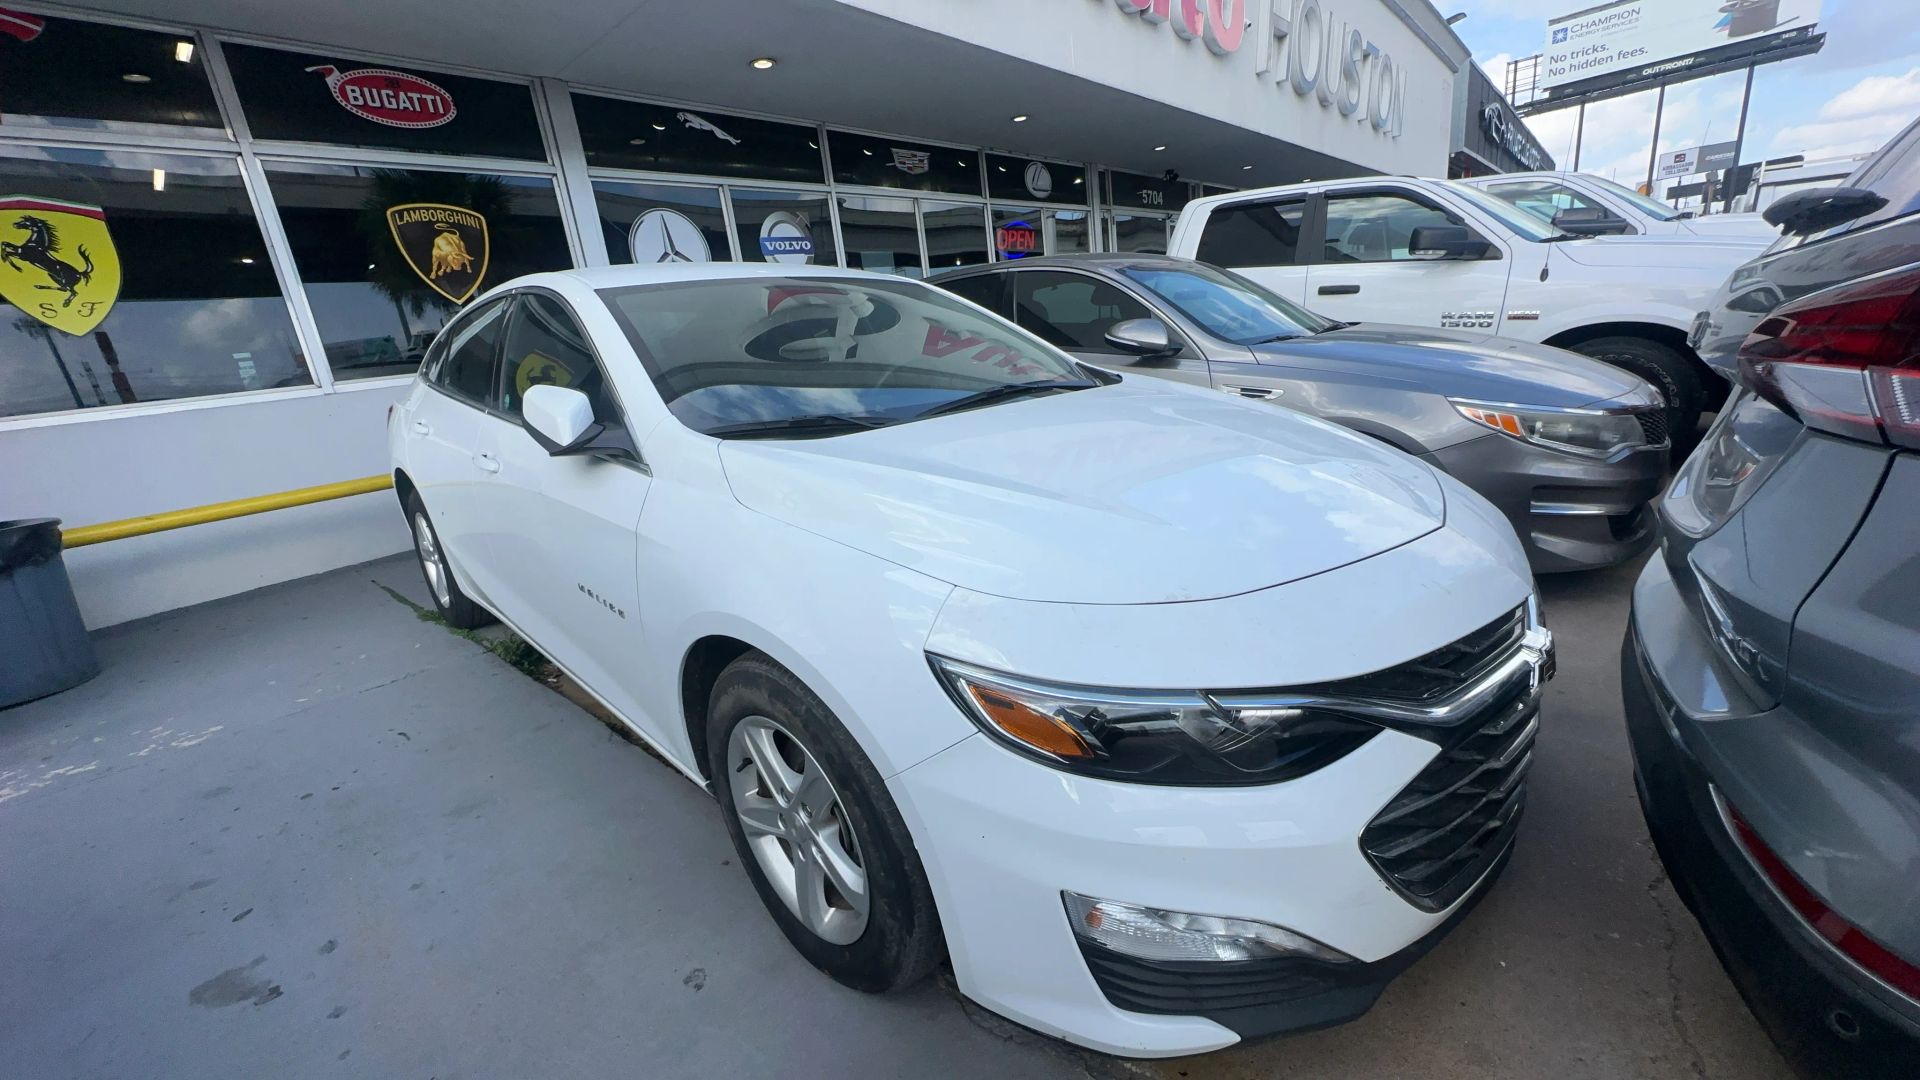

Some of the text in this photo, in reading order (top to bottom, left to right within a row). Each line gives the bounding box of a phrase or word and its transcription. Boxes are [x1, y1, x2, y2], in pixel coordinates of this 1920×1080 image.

[1569, 28, 1600, 41] ENERGY
[1601, 16, 1642, 31] SERVICES
[1570, 7, 1641, 33] CHAMPION
[1548, 46, 1648, 78] No hidden fees.
[1549, 43, 1609, 65] No tricks.
[1256, 0, 1408, 139] HOUSTON
[345, 85, 444, 114] BUGATTI
[1142, 189, 1164, 206] 5704
[395, 209, 480, 229] LAMBORGHINI
[764, 241, 811, 251] VOLVO
[996, 228, 1035, 250] OPEN
[39, 303, 58, 319] S
[1441, 311, 1495, 320] RAM
[1441, 320, 1493, 328] 1500
